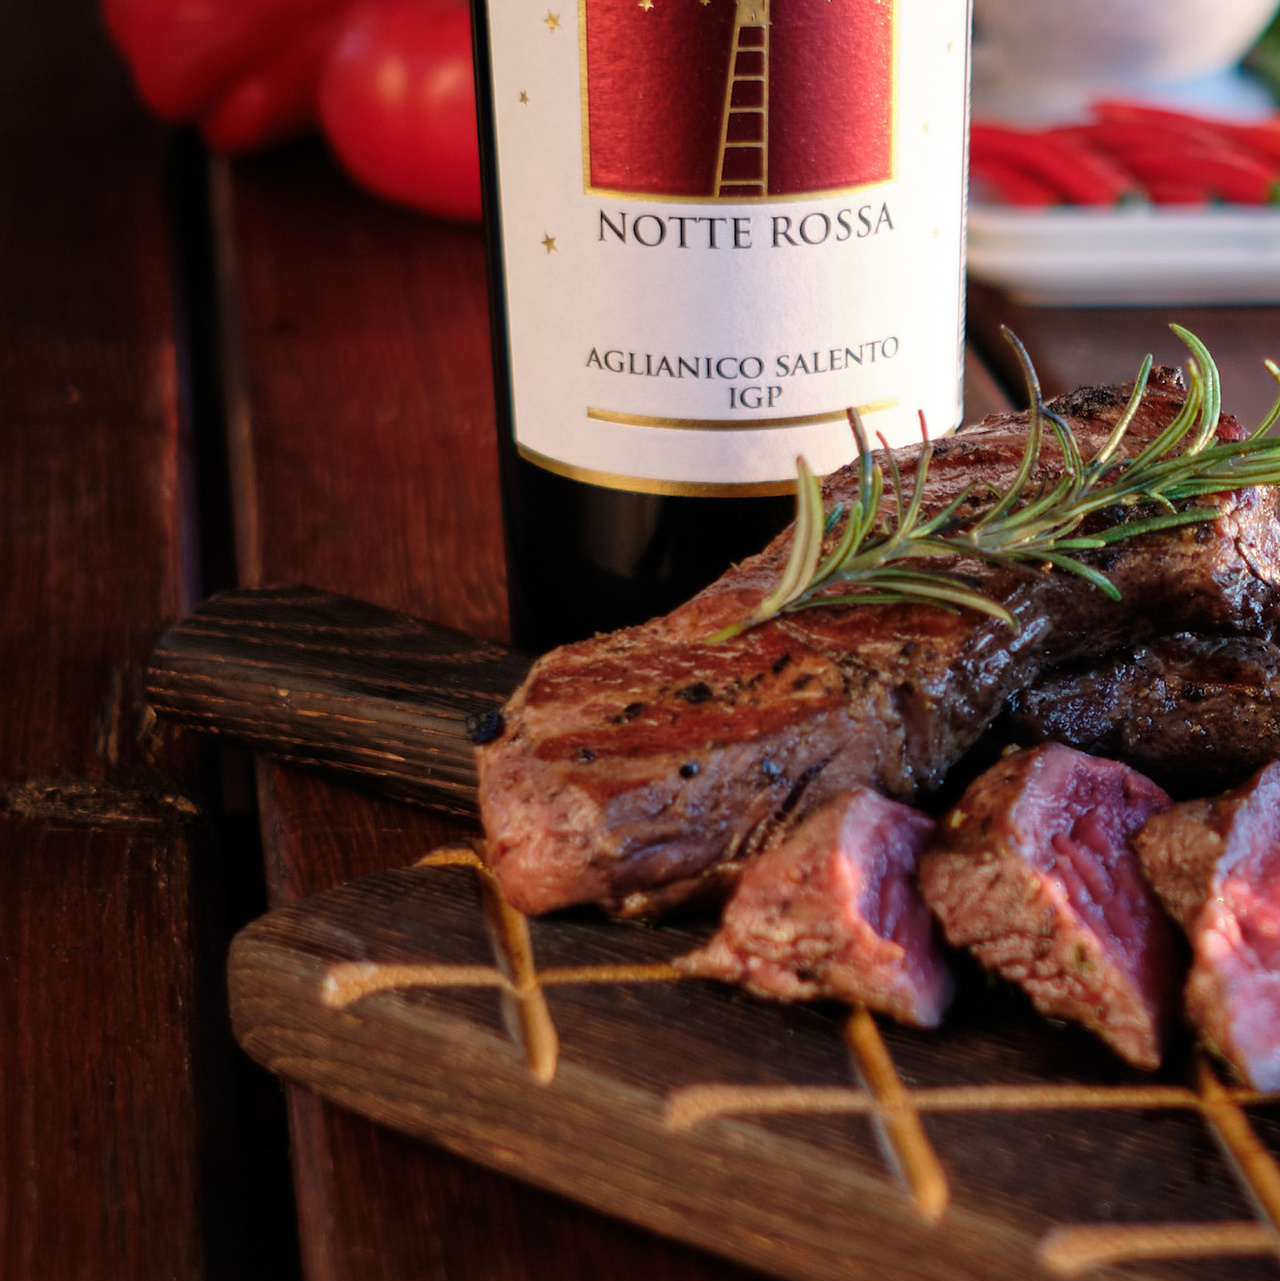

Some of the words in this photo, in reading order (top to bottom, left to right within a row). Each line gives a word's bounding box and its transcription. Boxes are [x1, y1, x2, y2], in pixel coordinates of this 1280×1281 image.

[598, 208, 753, 250] NOTTE
[771, 201, 894, 248] ROSSA
[586, 347, 765, 380] AGLIANICO
[776, 336, 900, 378] SALENTO
[729, 385, 783, 410] IGP
